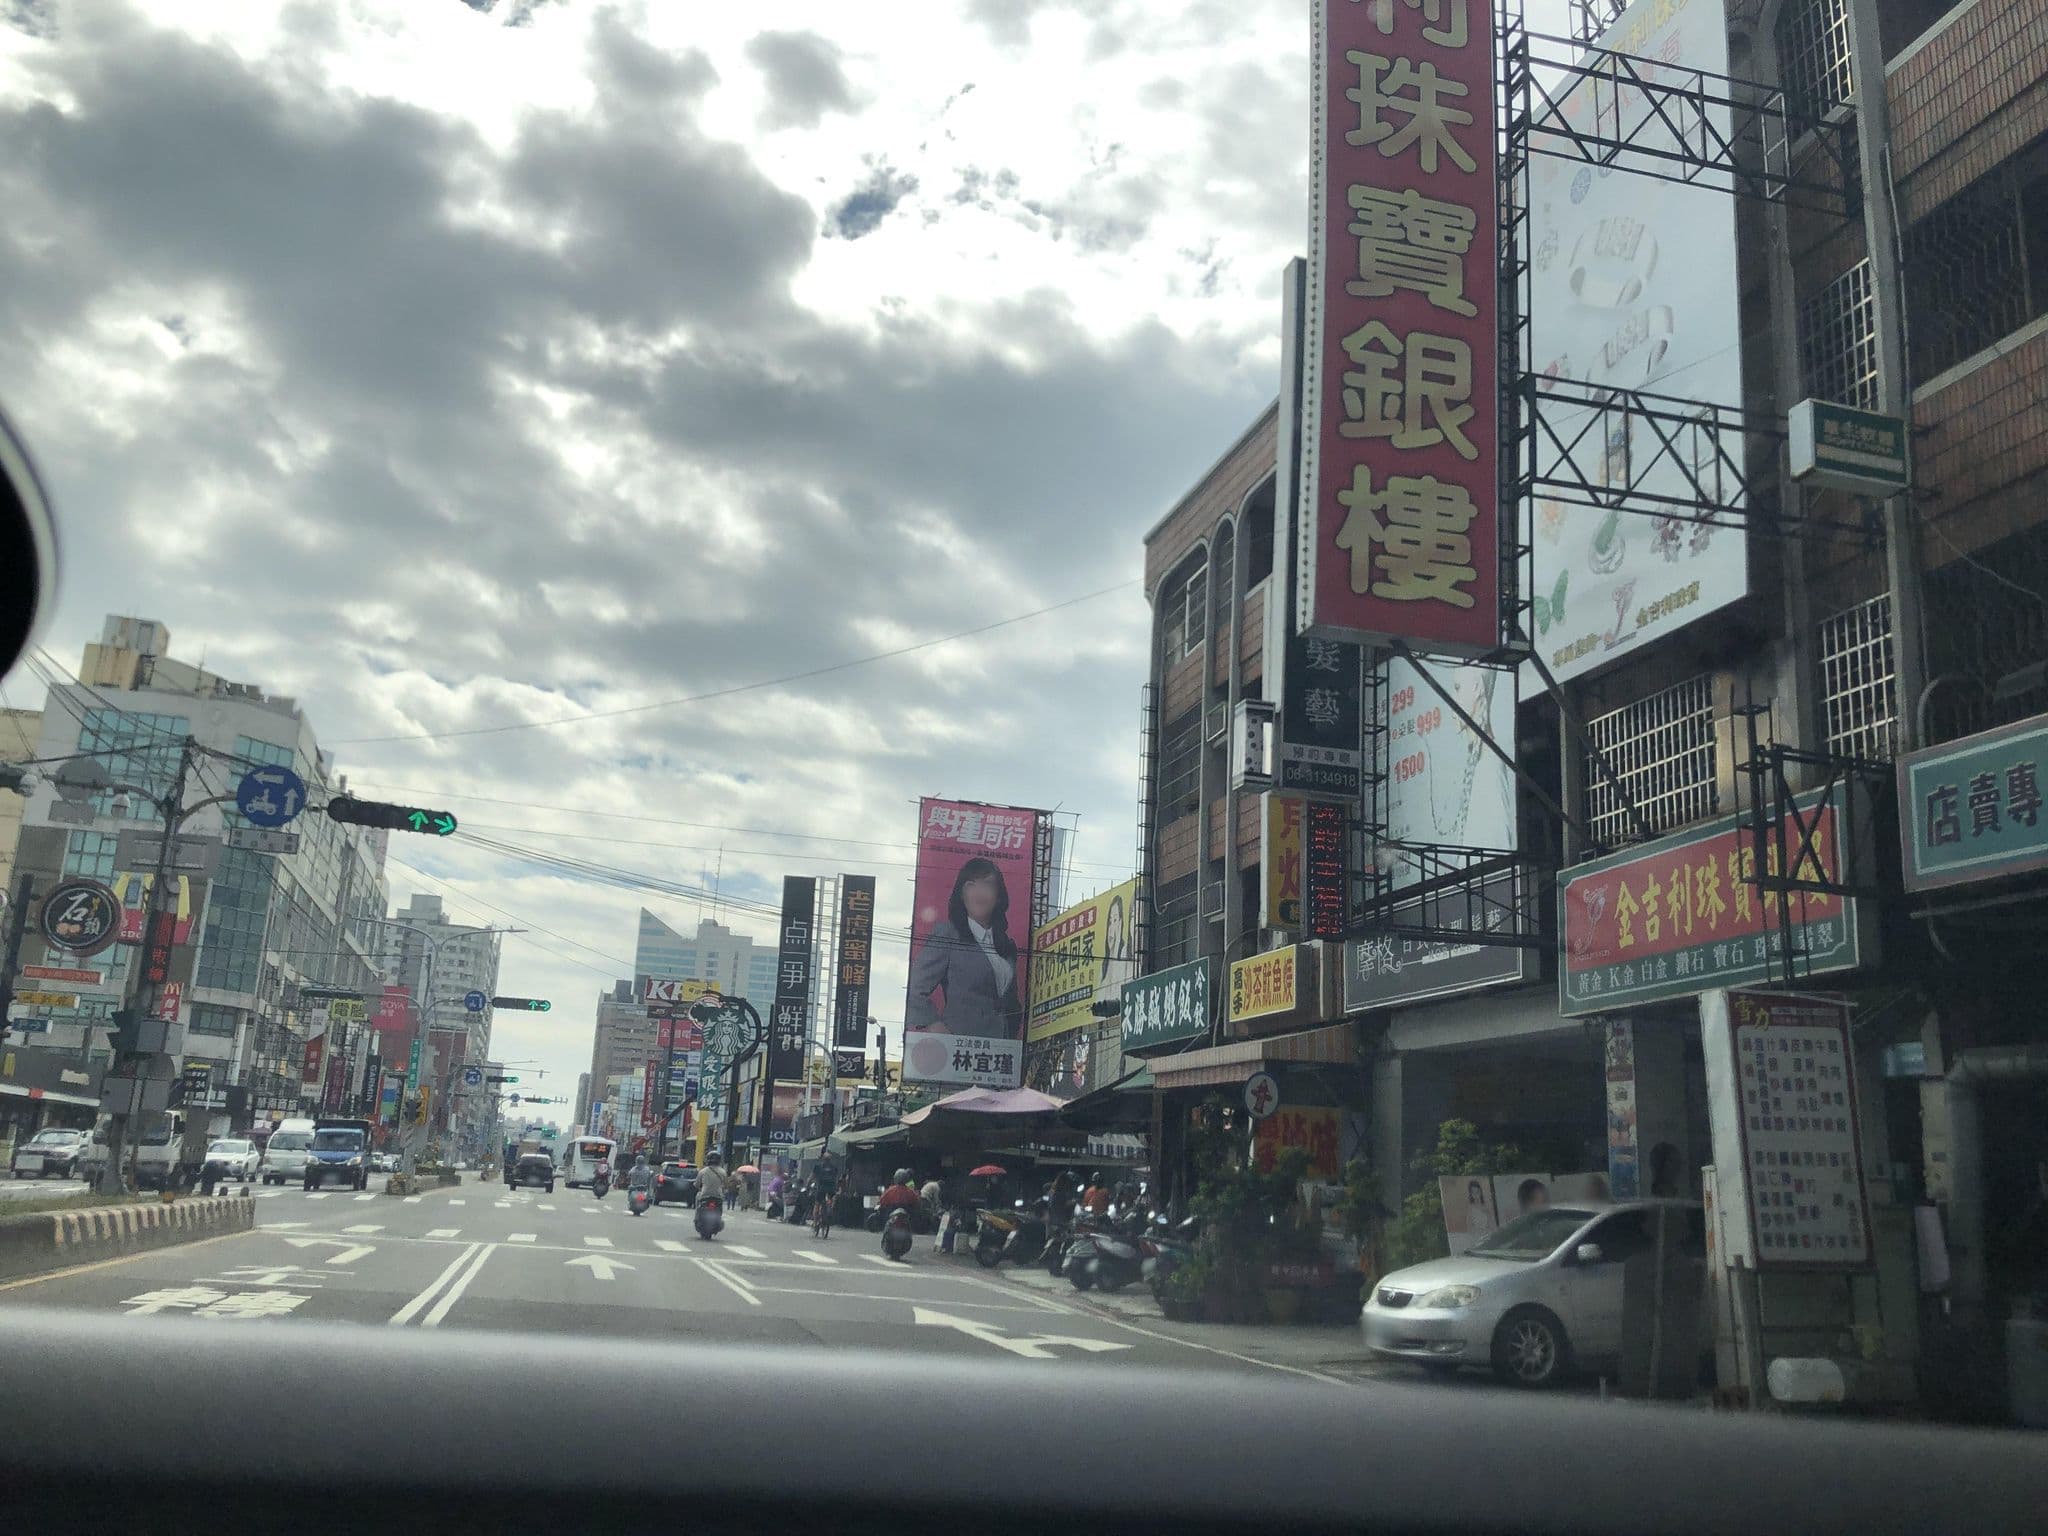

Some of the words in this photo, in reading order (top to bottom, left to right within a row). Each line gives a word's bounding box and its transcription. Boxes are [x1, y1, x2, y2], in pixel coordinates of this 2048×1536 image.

[1391, 685, 1415, 715] 299
[1393, 751, 1425, 784] 1500
[952, 1049, 1014, 1075] 林宜瑾
[366, 1064, 378, 1103] GARMIN
